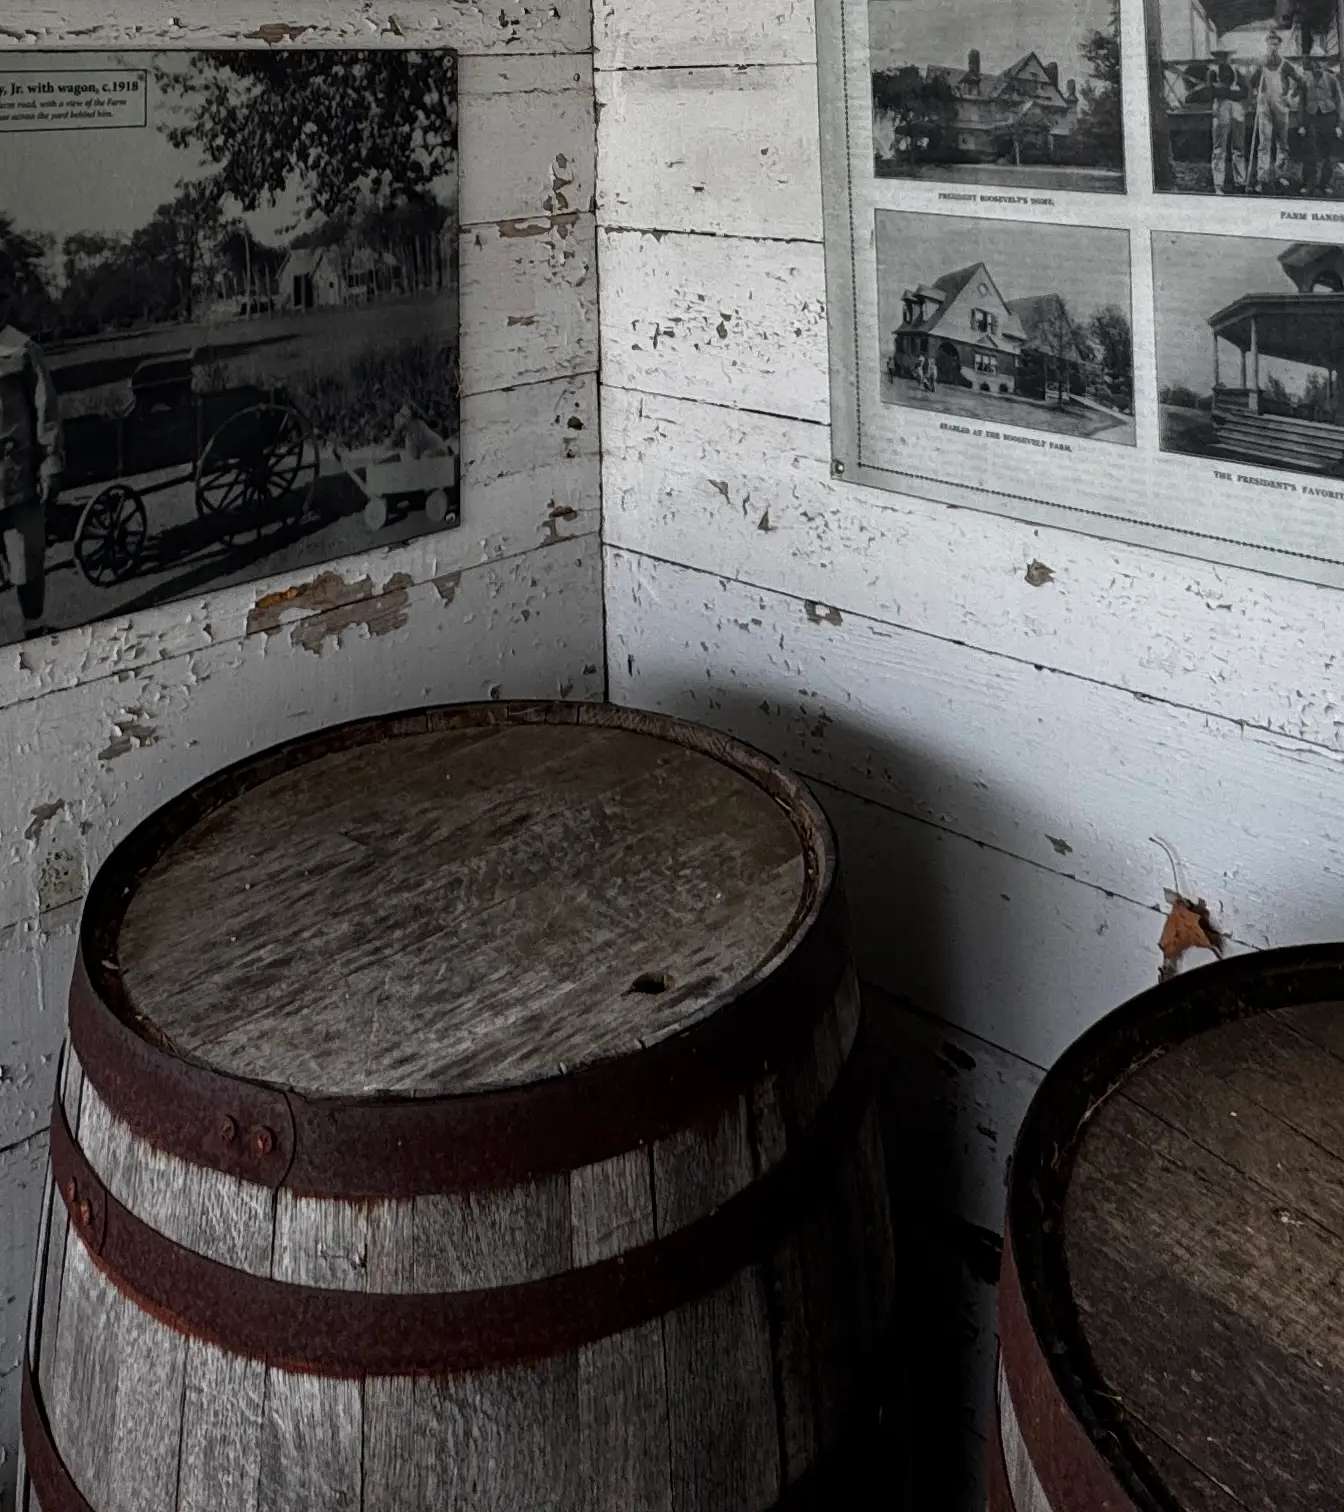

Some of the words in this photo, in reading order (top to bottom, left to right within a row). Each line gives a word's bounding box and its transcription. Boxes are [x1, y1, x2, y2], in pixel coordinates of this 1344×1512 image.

[10, 82, 24, 96] Jr.
[27, 81, 55, 94] with
[57, 83, 100, 96] wagon,
[101, 81, 139, 93] c.1918
[39, 99, 57, 108] with
[65, 99, 84, 107] view
[85, 98, 93, 108] of
[93, 98, 106, 107] the
[106, 97, 127, 106] Farm
[37, 111, 49, 120] the
[69, 110, 96, 119] behind
[1213, 470, 1232, 481] THE
